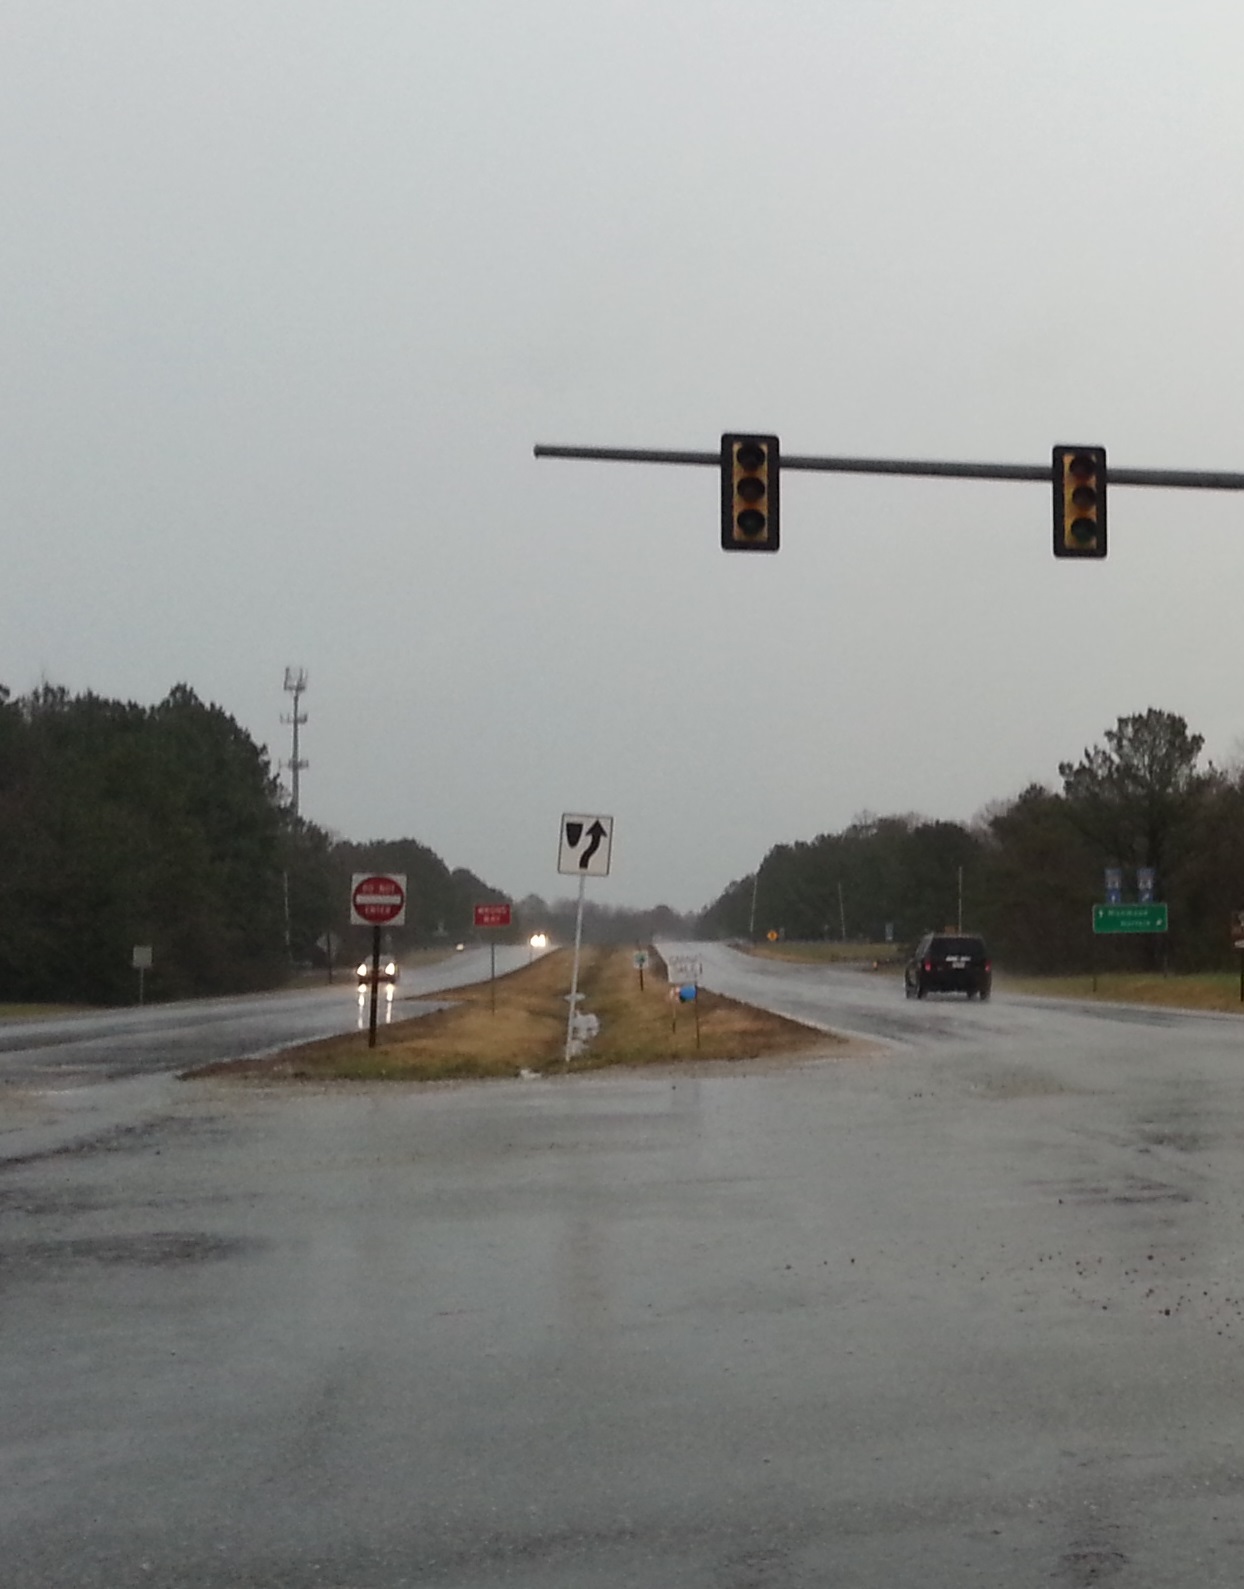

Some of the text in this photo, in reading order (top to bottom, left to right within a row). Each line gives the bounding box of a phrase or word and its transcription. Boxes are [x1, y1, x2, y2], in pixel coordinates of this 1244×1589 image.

[362, 884, 396, 895] DO NOT
[365, 904, 392, 915] ENTER
[478, 906, 507, 914] WRONG
